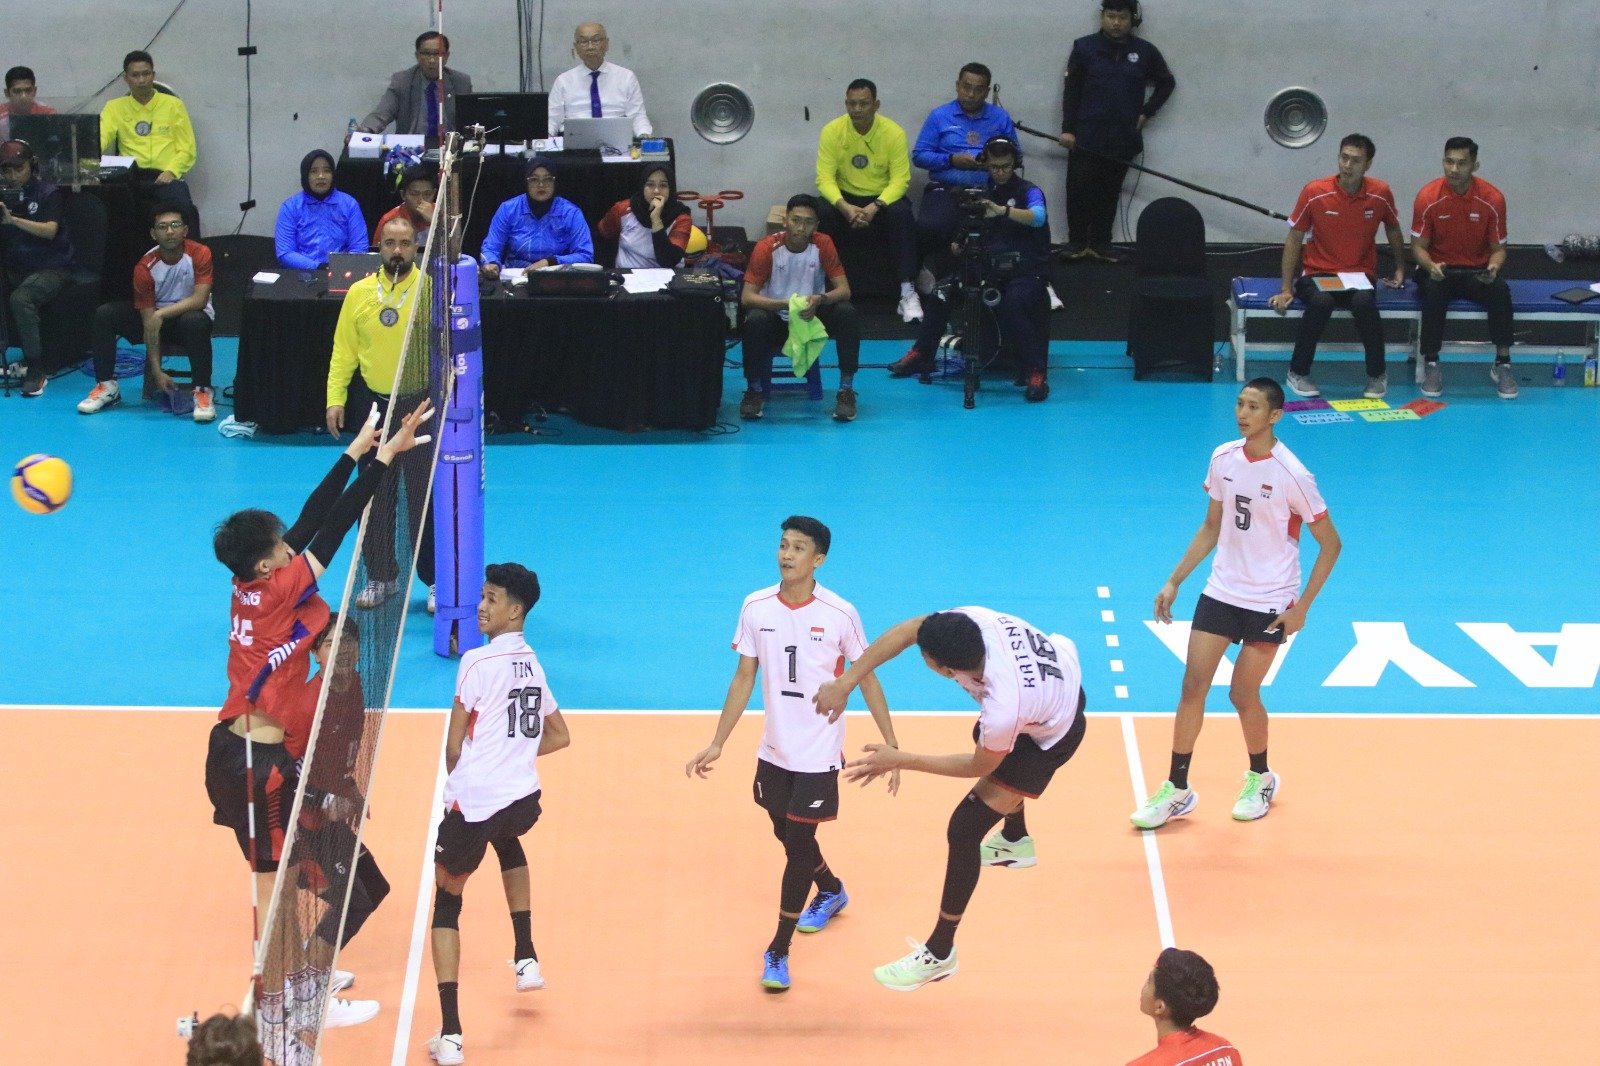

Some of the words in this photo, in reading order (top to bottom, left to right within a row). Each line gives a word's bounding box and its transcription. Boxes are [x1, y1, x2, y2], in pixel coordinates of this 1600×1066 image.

[1235, 494, 1252, 531] 5
[512, 661, 534, 679] TIN
[784, 645, 798, 683] 1
[1024, 628, 1065, 682] 16
[507, 686, 542, 739] 18
